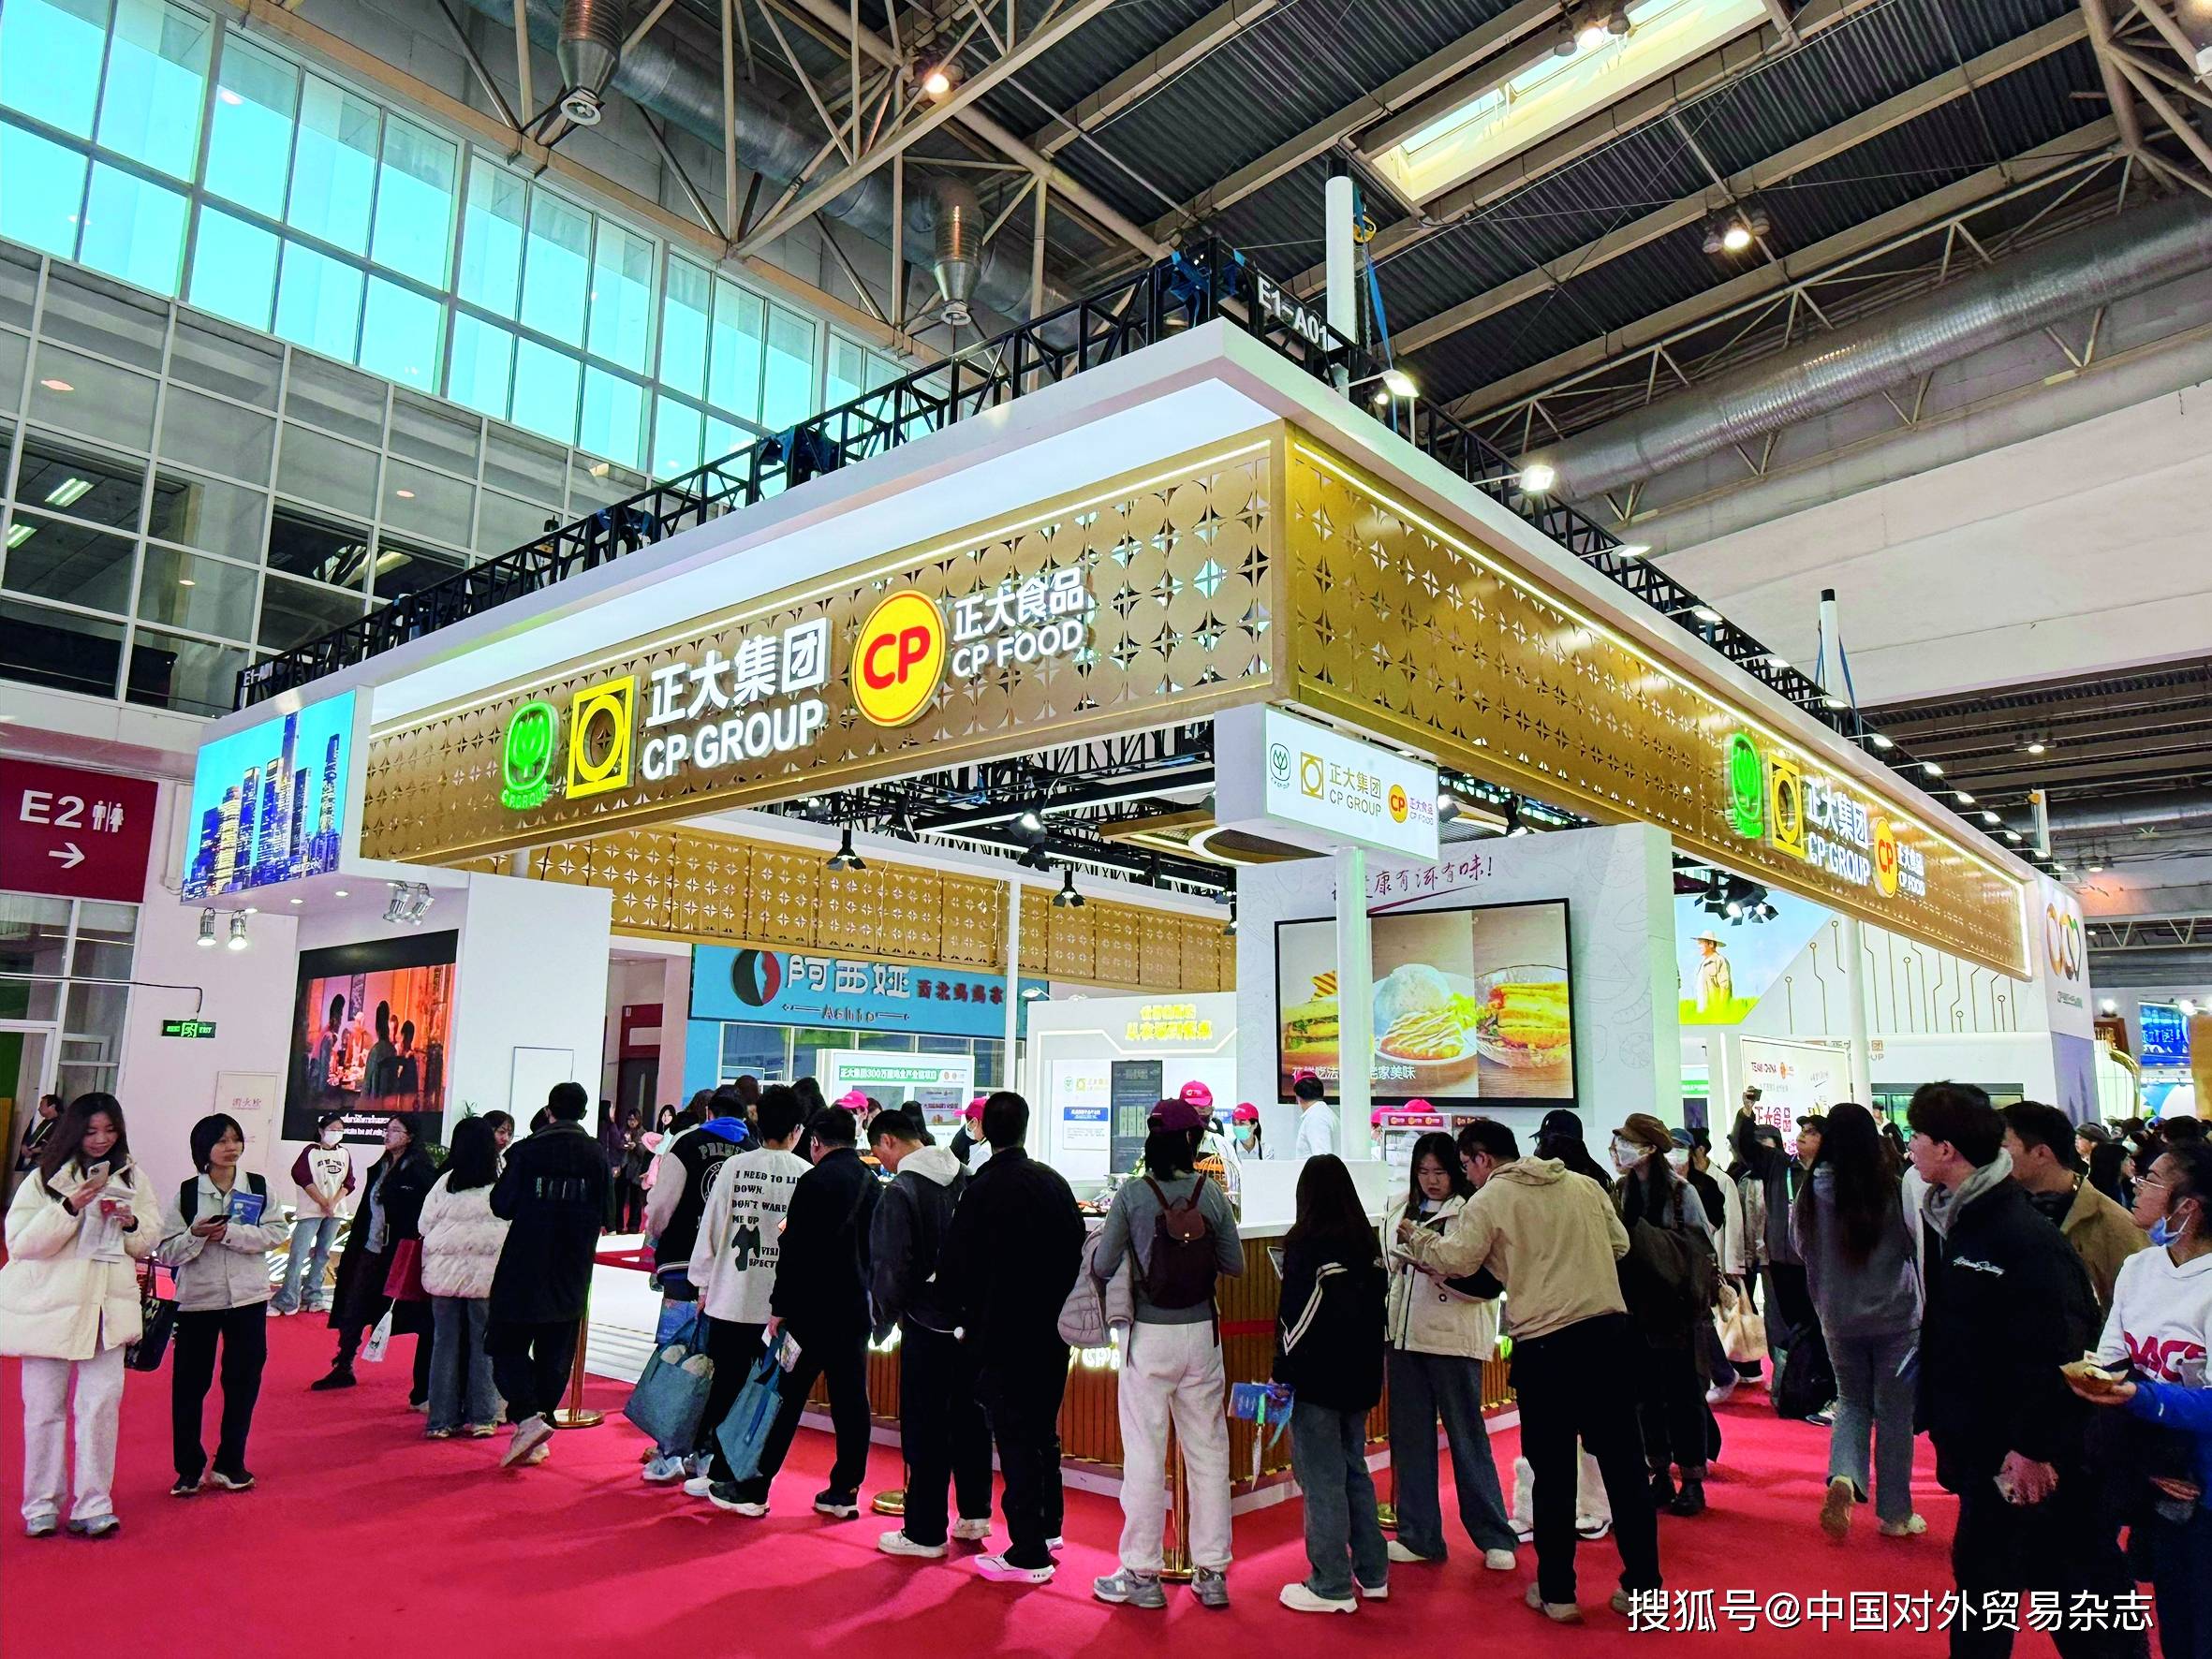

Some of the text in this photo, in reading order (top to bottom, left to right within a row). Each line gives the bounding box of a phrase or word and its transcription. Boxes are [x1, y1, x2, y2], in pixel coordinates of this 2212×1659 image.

[1257, 274, 1328, 352] E1-A01
[953, 566, 1084, 642] 正大食品
[646, 617, 828, 727] 正大集团
[863, 625, 931, 690] CP
[951, 619, 1084, 678] CP FOOD
[641, 698, 825, 781] CP GROUP
[1329, 762, 1381, 800] 正大集团
[1329, 788, 1381, 817] CP GROUP
[1390, 791, 1406, 812] CP
[19, 789, 84, 829] E2
[1806, 775, 1869, 850] 正大集团
[1808, 831, 1871, 887] CP GROUP
[1878, 839, 1894, 874] CP
[788, 954, 910, 999] 阿西娅
[744, 1170, 768, 1181] NEED
[771, 1174, 783, 1183] TO
[731, 1214, 759, 1225] ME UP
